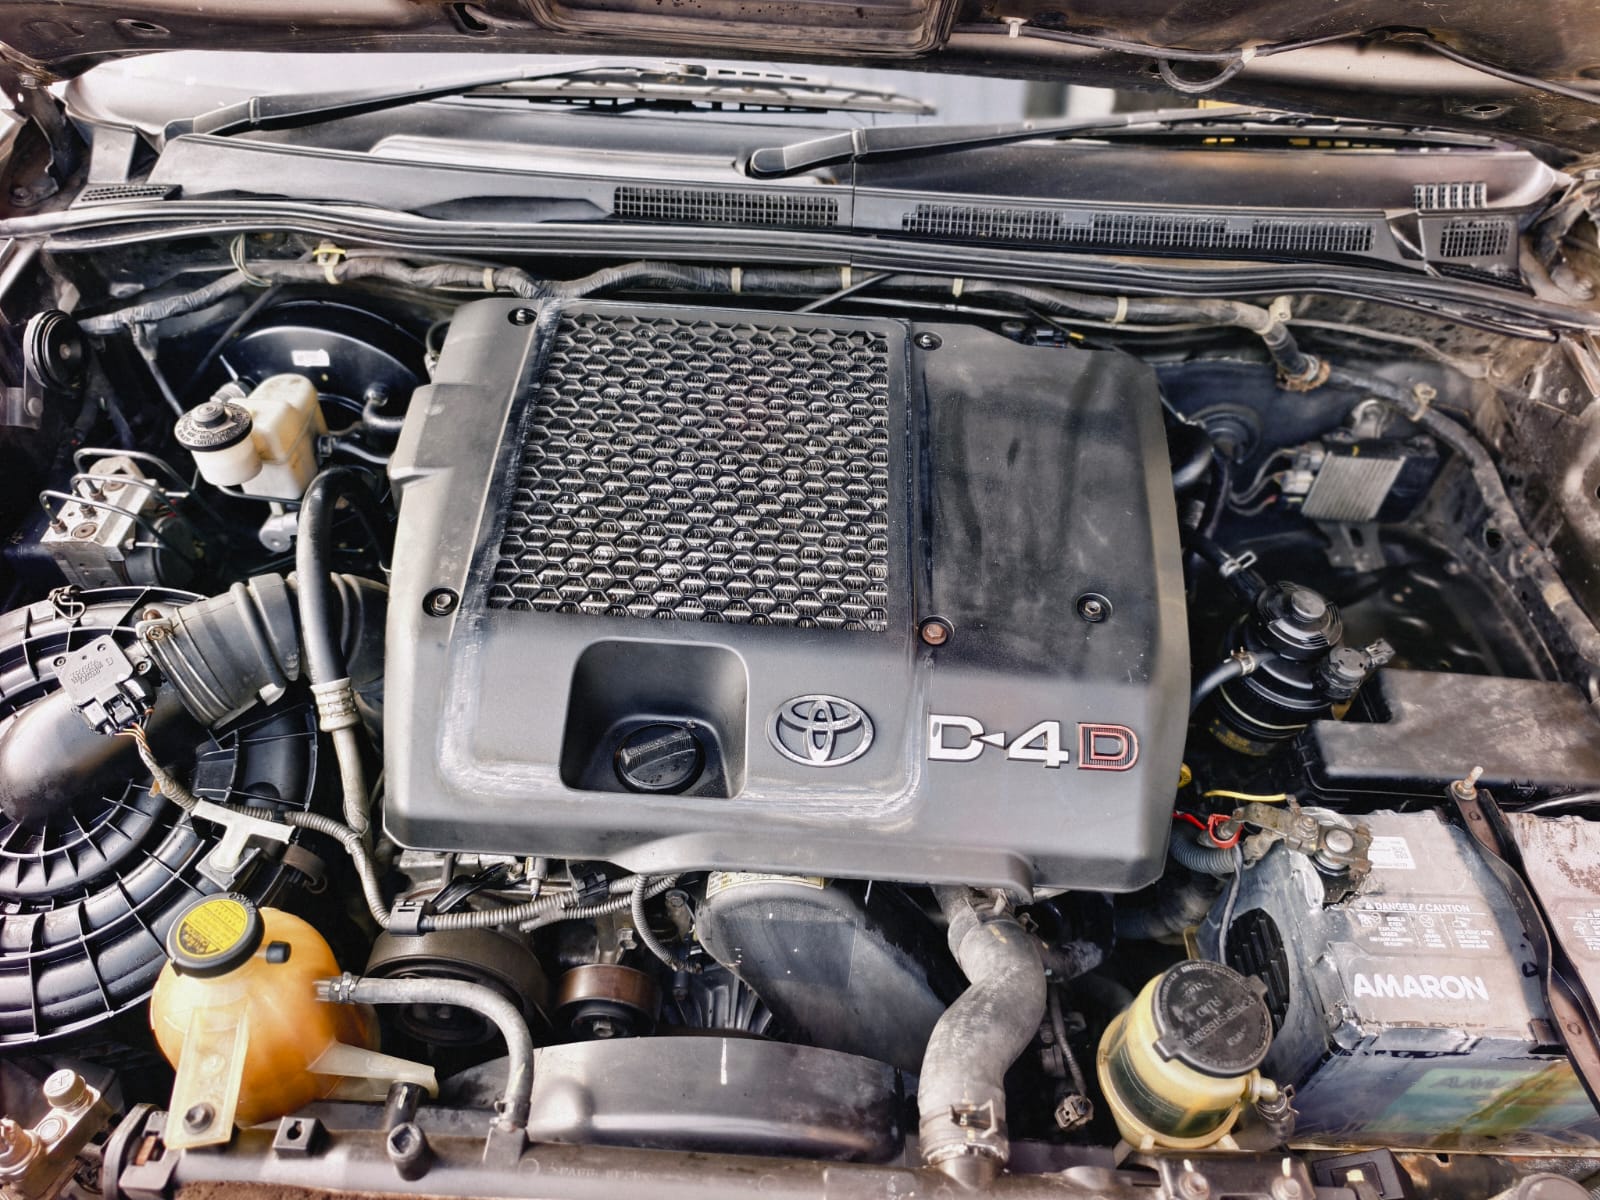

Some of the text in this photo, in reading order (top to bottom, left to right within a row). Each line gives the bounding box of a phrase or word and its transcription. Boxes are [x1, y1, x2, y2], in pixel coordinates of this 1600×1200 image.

[1375, 902, 1416, 912] DANGER
[1425, 903, 1471, 913] CAUTION
[1353, 973, 1490, 1000] AMARON
